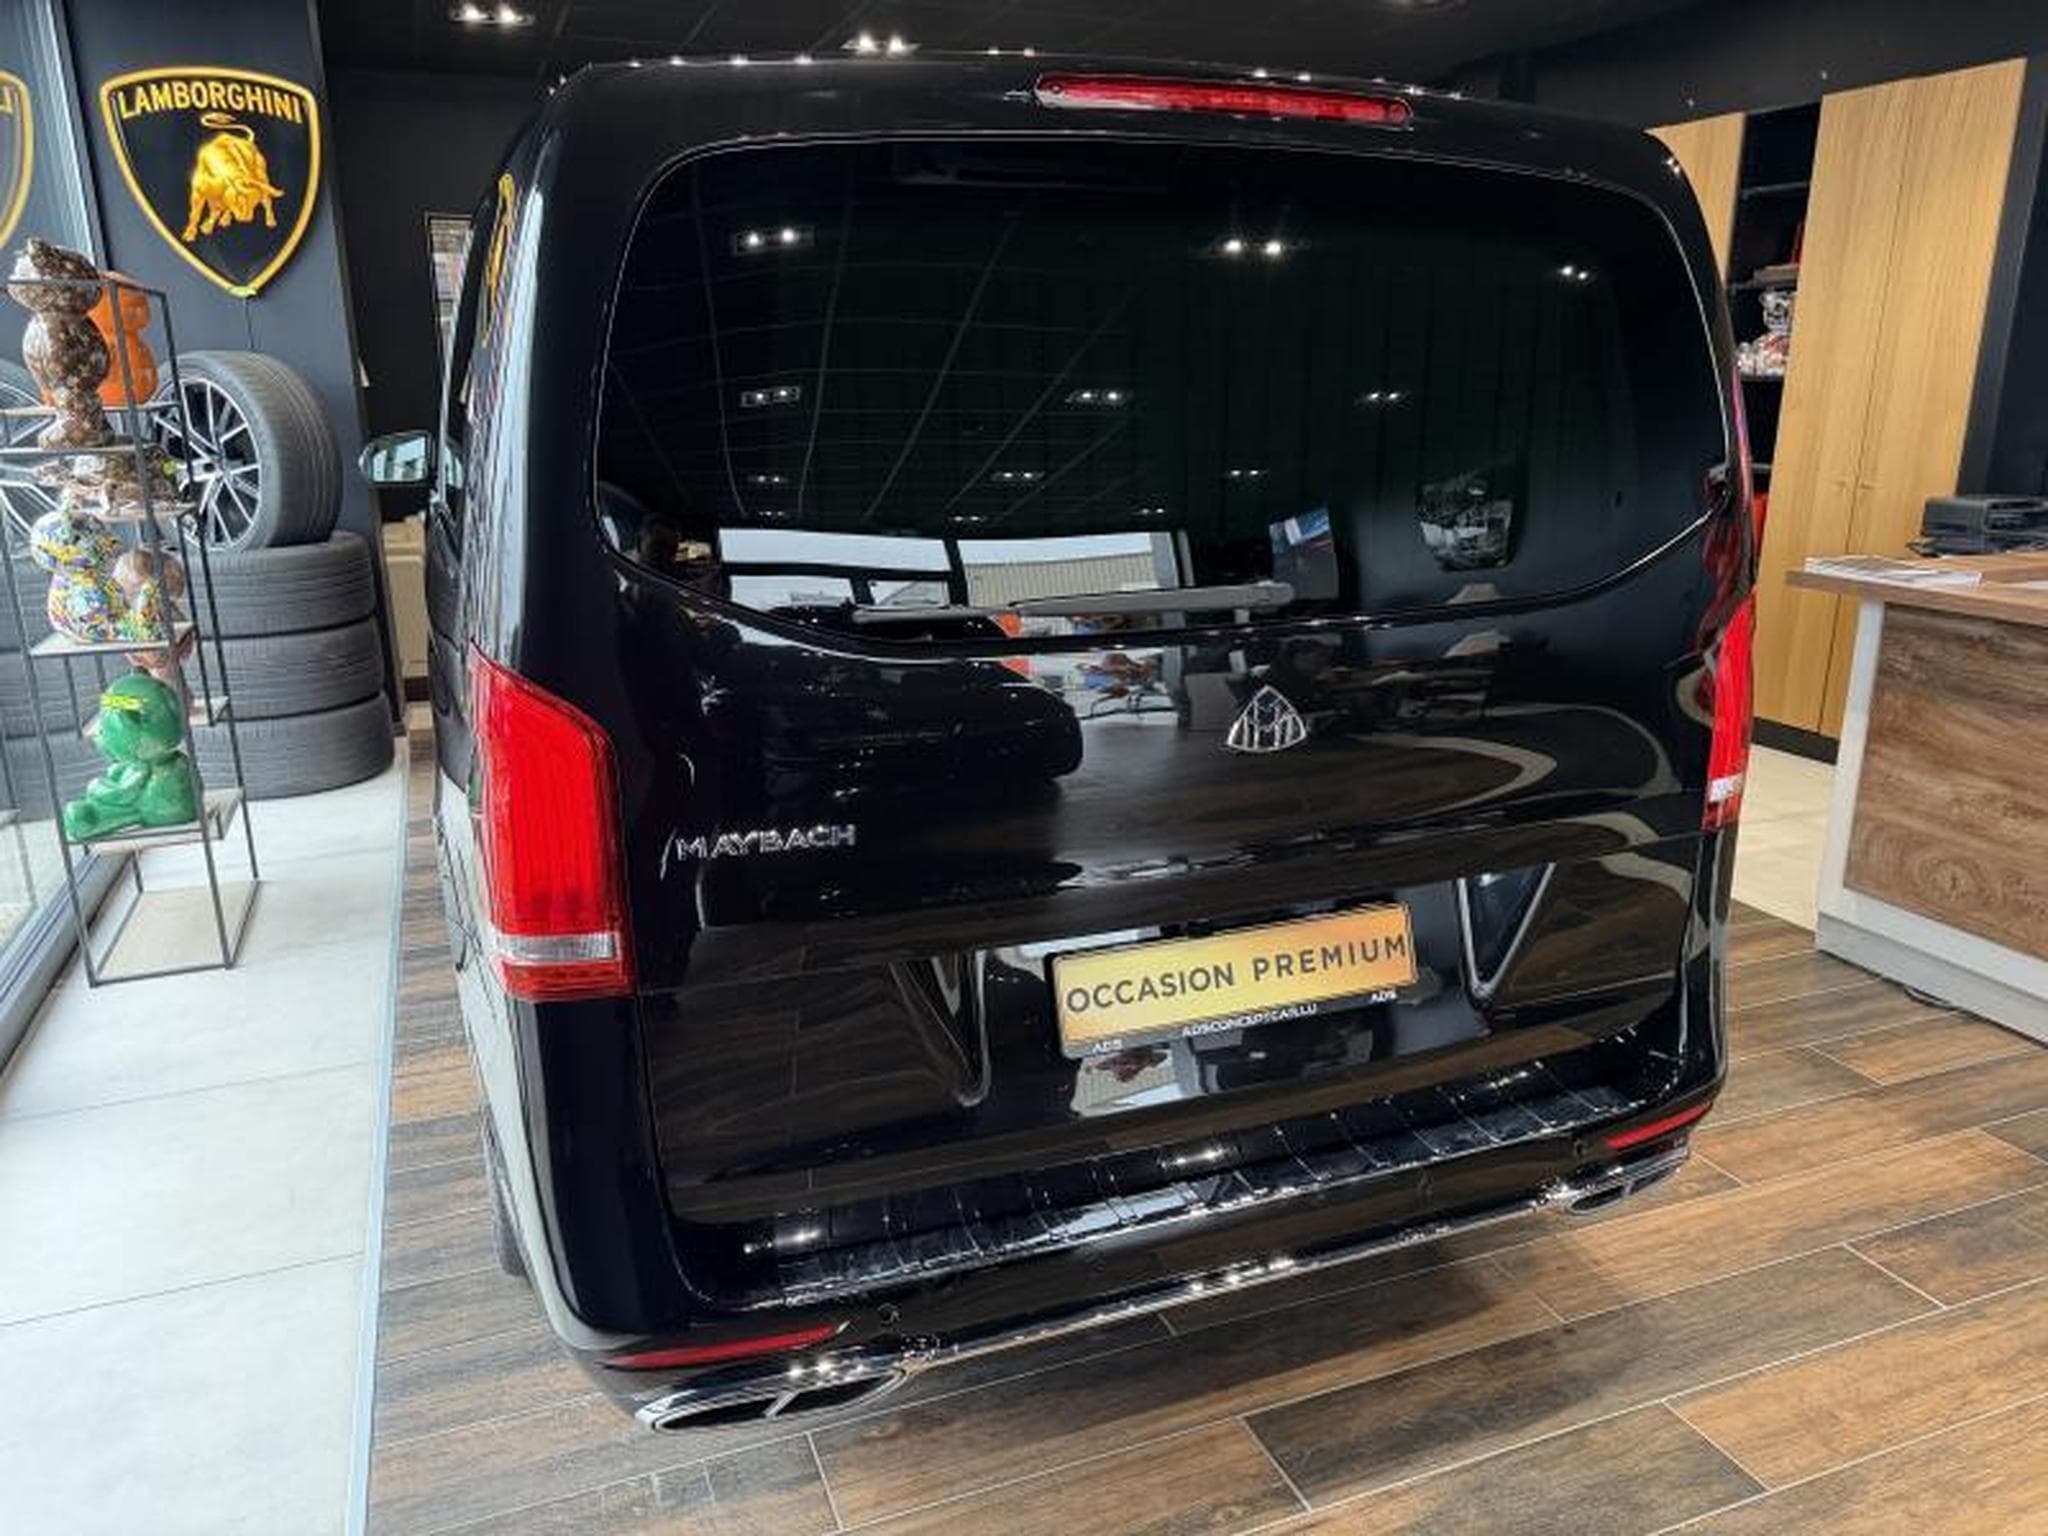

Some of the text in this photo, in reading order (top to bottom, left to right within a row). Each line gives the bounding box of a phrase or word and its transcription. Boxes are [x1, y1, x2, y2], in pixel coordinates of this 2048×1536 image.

[117, 80, 303, 123] LAMBORGHINI
[675, 824, 856, 861] MAYBACH
[1066, 933, 1406, 1013] OCCASION PREMIUM
